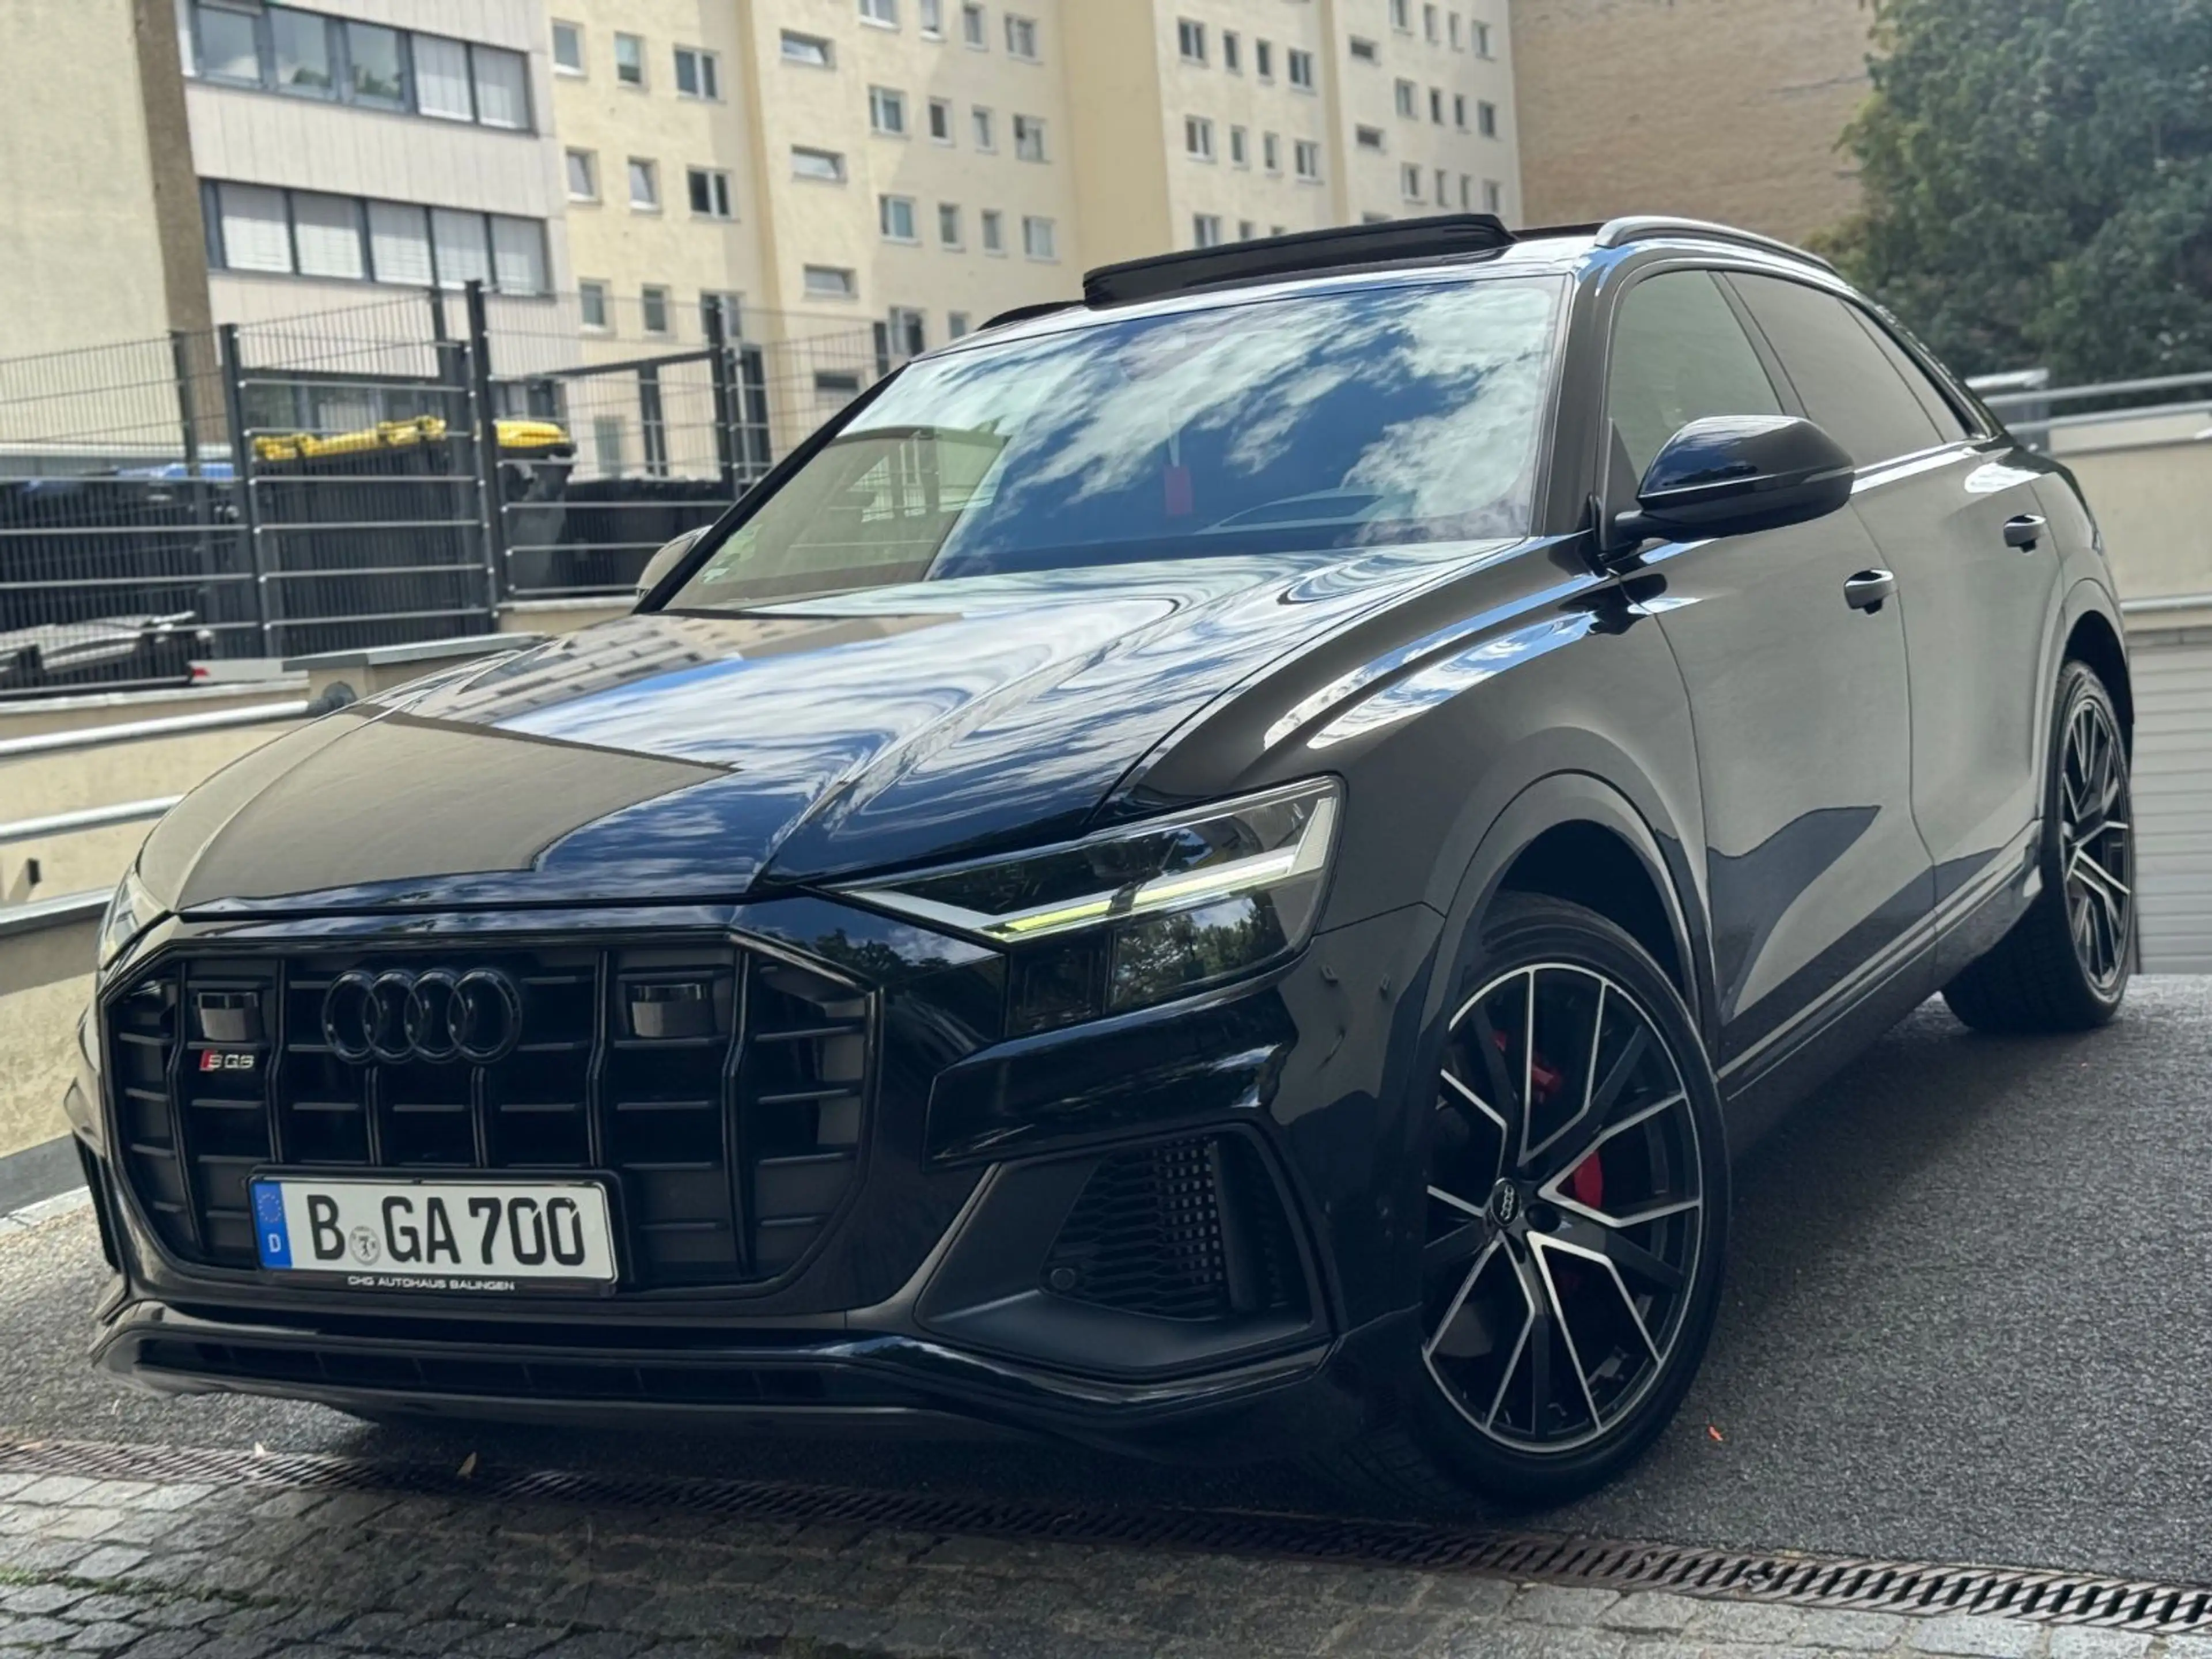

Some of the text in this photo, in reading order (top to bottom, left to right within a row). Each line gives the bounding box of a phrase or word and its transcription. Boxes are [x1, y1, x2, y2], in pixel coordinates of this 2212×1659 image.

[306, 1194, 585, 1266] B GA 700
[267, 1233, 282, 1253] D
[377, 1277, 446, 1289] AUTOHAUS
